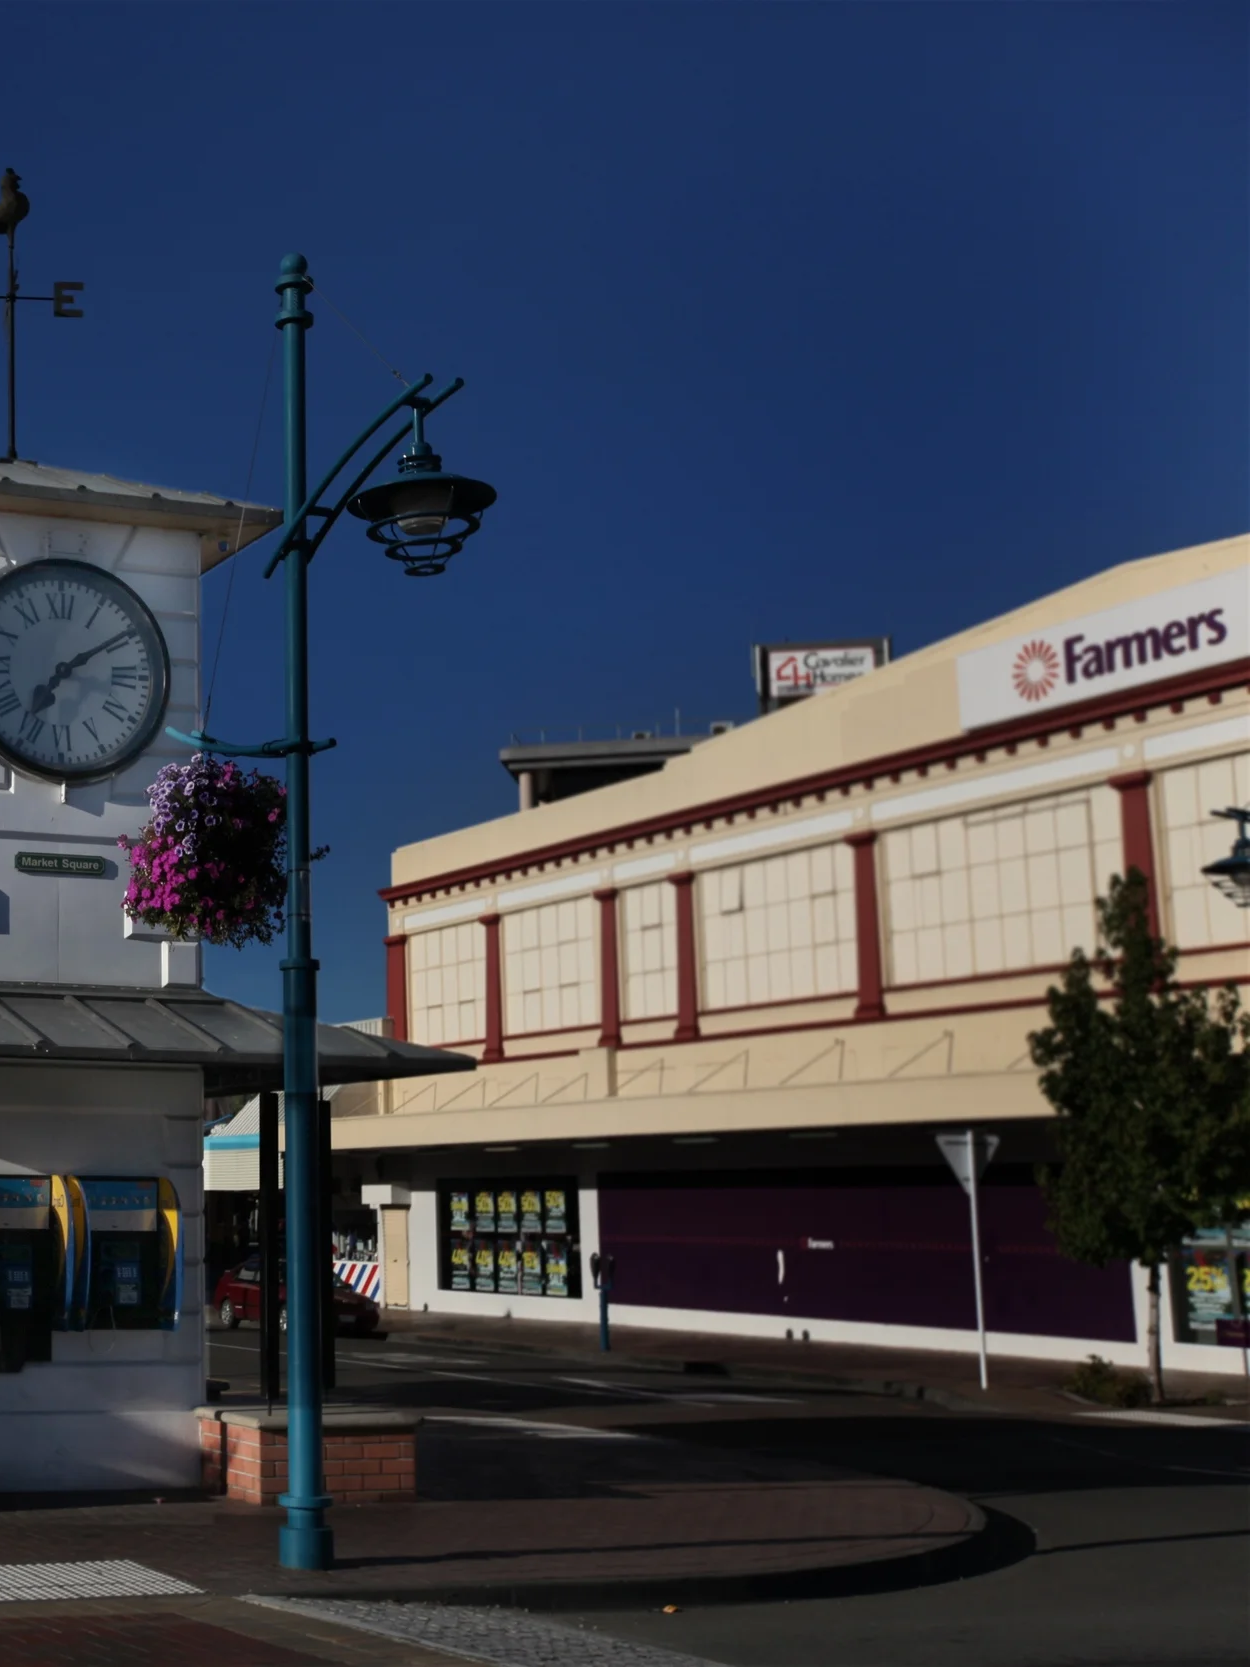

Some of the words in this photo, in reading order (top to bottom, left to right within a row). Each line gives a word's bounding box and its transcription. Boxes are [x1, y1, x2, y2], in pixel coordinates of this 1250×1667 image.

[54, 282, 84, 317] E
[13, 597, 40, 630] XI
[45, 592, 74, 620] XII
[1064, 608, 1227, 683] Farmers
[21, 856, 58, 868] Market
[62, 858, 99, 871] Square
